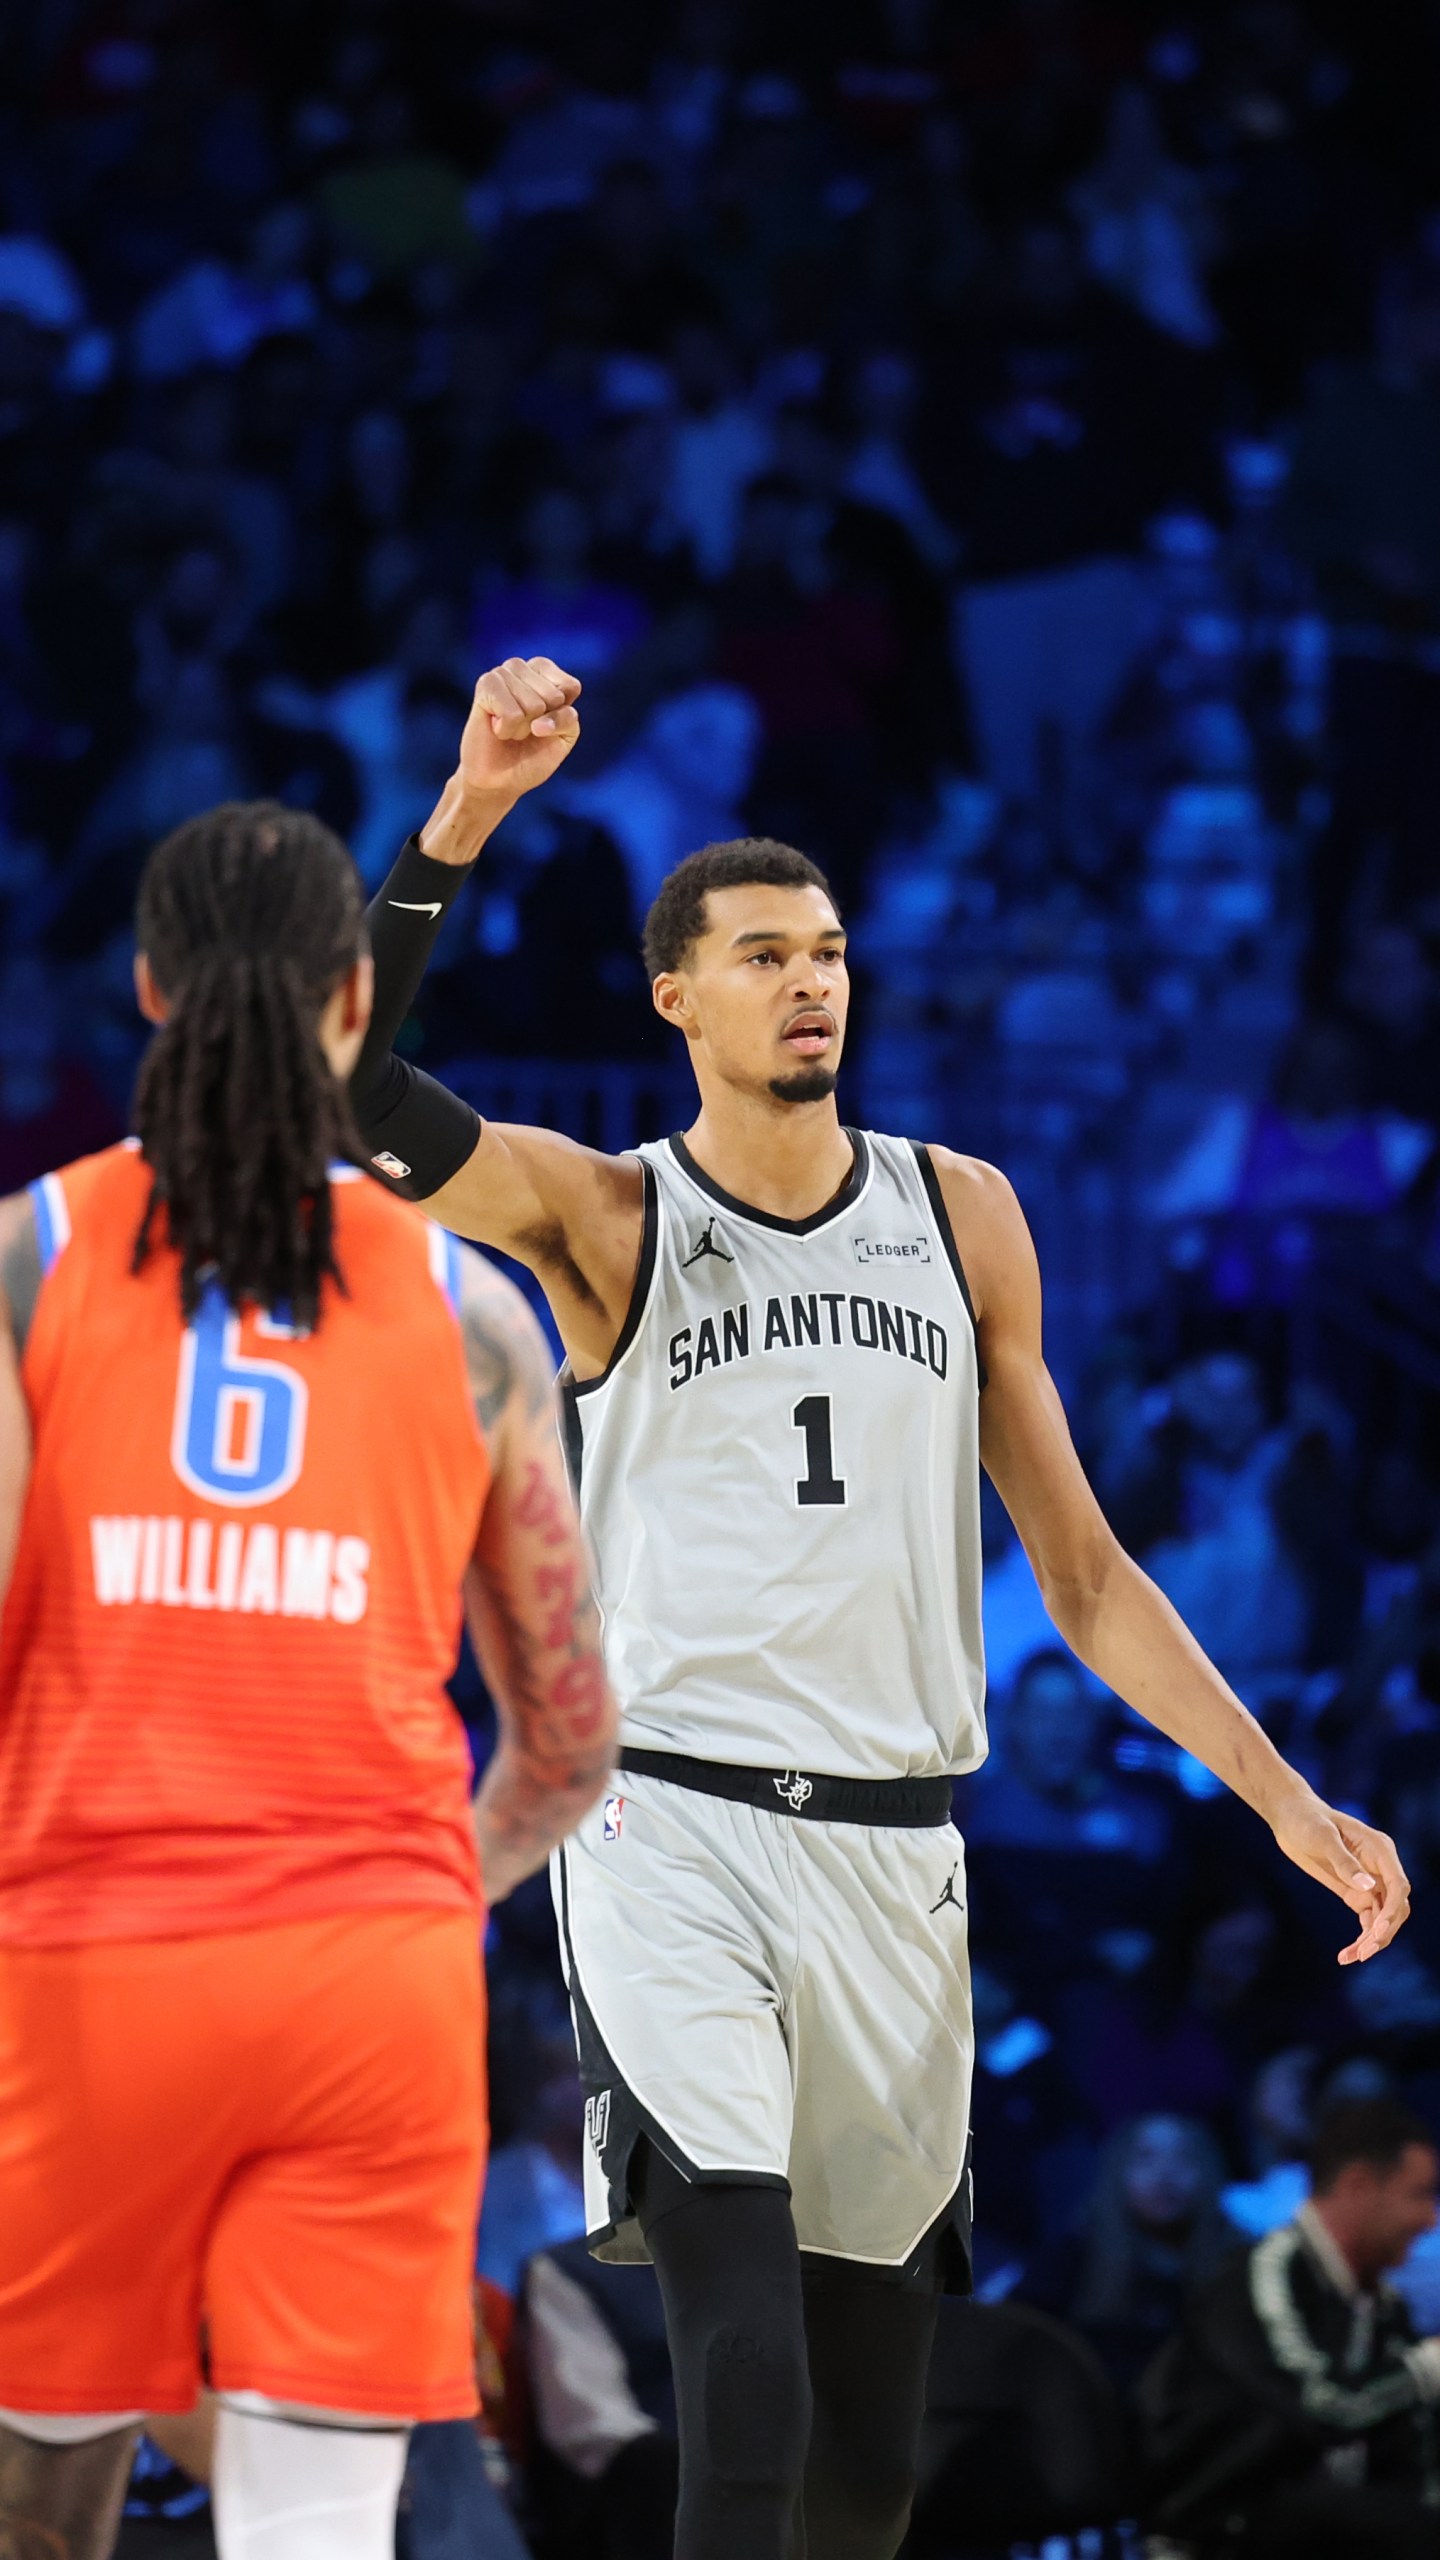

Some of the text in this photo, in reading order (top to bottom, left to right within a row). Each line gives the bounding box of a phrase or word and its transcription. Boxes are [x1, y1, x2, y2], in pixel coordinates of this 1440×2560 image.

[865, 1244, 920, 1257] LEDGER
[170, 1264, 309, 1509] 6
[669, 1292, 948, 1391] SAN ANTONIO
[791, 1393, 849, 1508] 1
[90, 1515, 371, 1623] WILLIAMS
